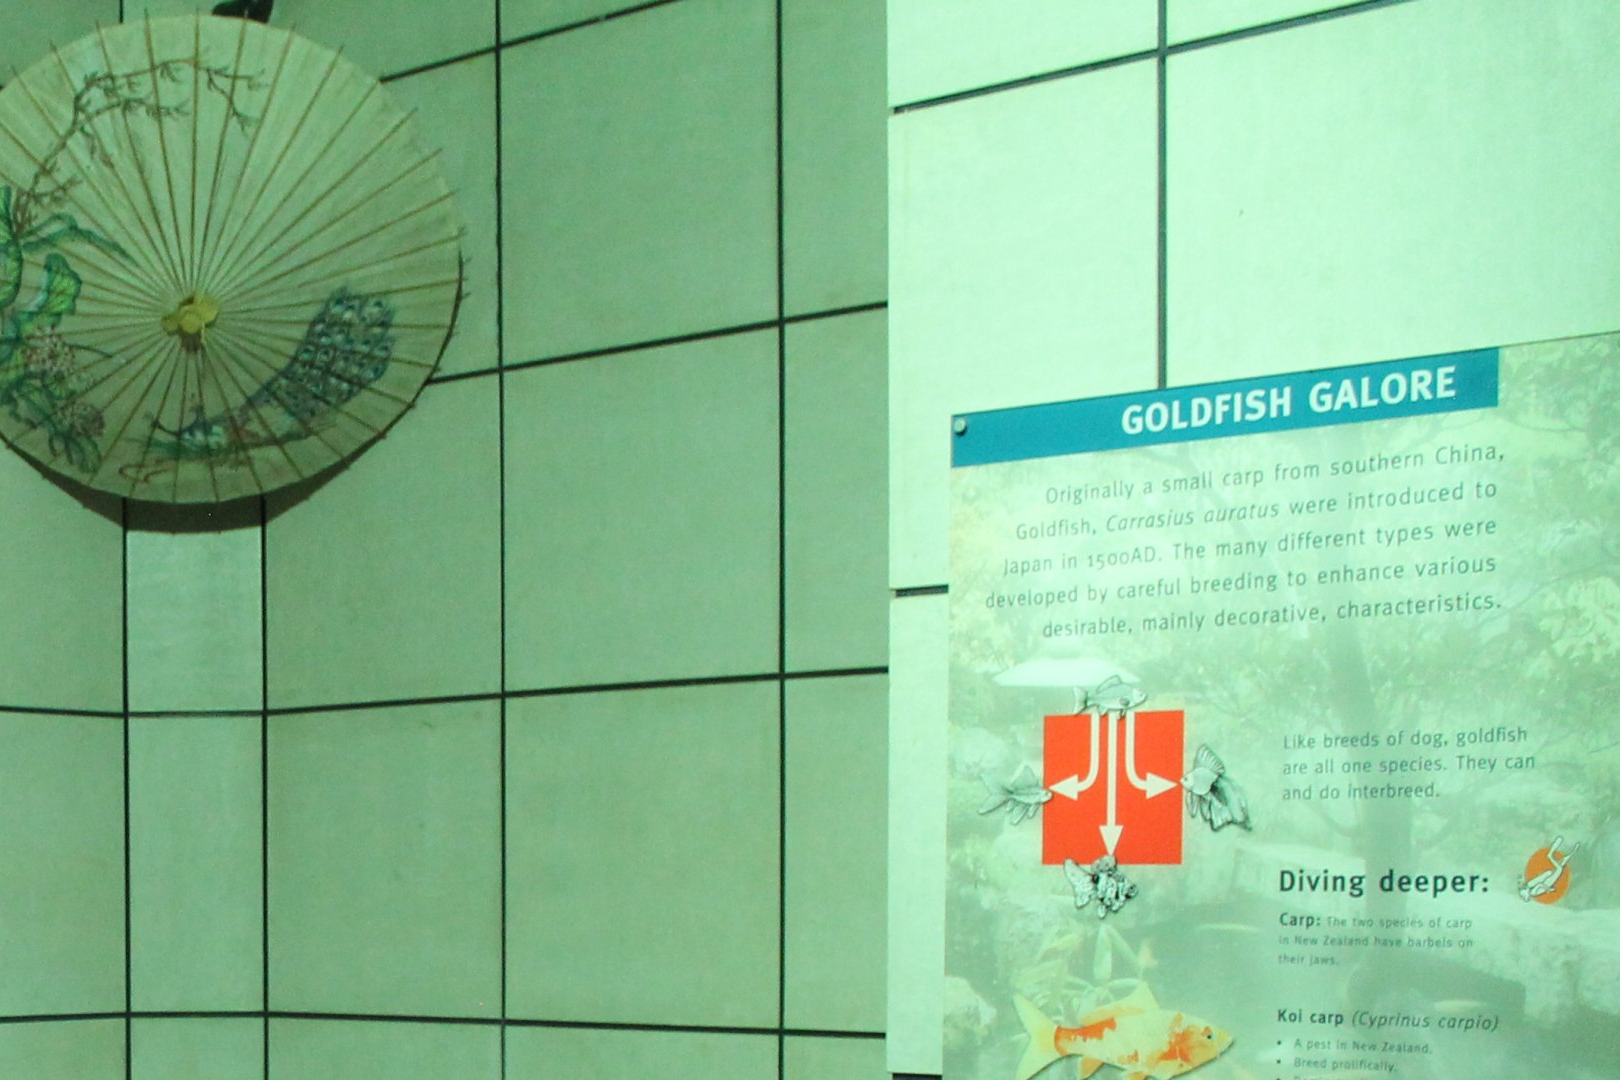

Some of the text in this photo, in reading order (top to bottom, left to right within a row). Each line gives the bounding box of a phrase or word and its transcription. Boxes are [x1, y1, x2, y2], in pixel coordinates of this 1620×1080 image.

[1121, 365, 1457, 435] GOLDFISH GALORE
[1045, 444, 1505, 505] Originally a small carp from southern China,
[1015, 481, 1498, 540] Goldfish, Carrasius auratus were introduced to
[1002, 521, 1497, 576] Japan in 1500AD. The many different types were
[984, 556, 1497, 608] developed by careful breeding to enhance various
[1042, 593, 1502, 638] desirable, mainly decorative, characteristics.
[1282, 726, 1528, 749] Like breeds of dog, goldfish
[1281, 754, 1537, 774] are all one species. They can
[1281, 782, 1441, 800] and do interbreed.
[1278, 868, 1490, 898] Diving deeper:
[1278, 912, 1473, 929] Carp: The two species of carp
[1292, 935, 1319, 945] New
[1322, 935, 1370, 946] Zealand
[1372, 936, 1402, 947] have
[1406, 936, 1453, 948] barbels
[1456, 938, 1475, 948] on
[1277, 953, 1340, 966] their jaws.
[1276, 1009, 1500, 1031] Koi carp (Cyprinus carpio)
[1292, 1037, 1303, 1048] A
[1304, 1040, 1332, 1050] pest
[1350, 1040, 1378, 1051] New
[1380, 1041, 1434, 1054] Zealand.
[1292, 1057, 1398, 1072] Breed prolifically.
